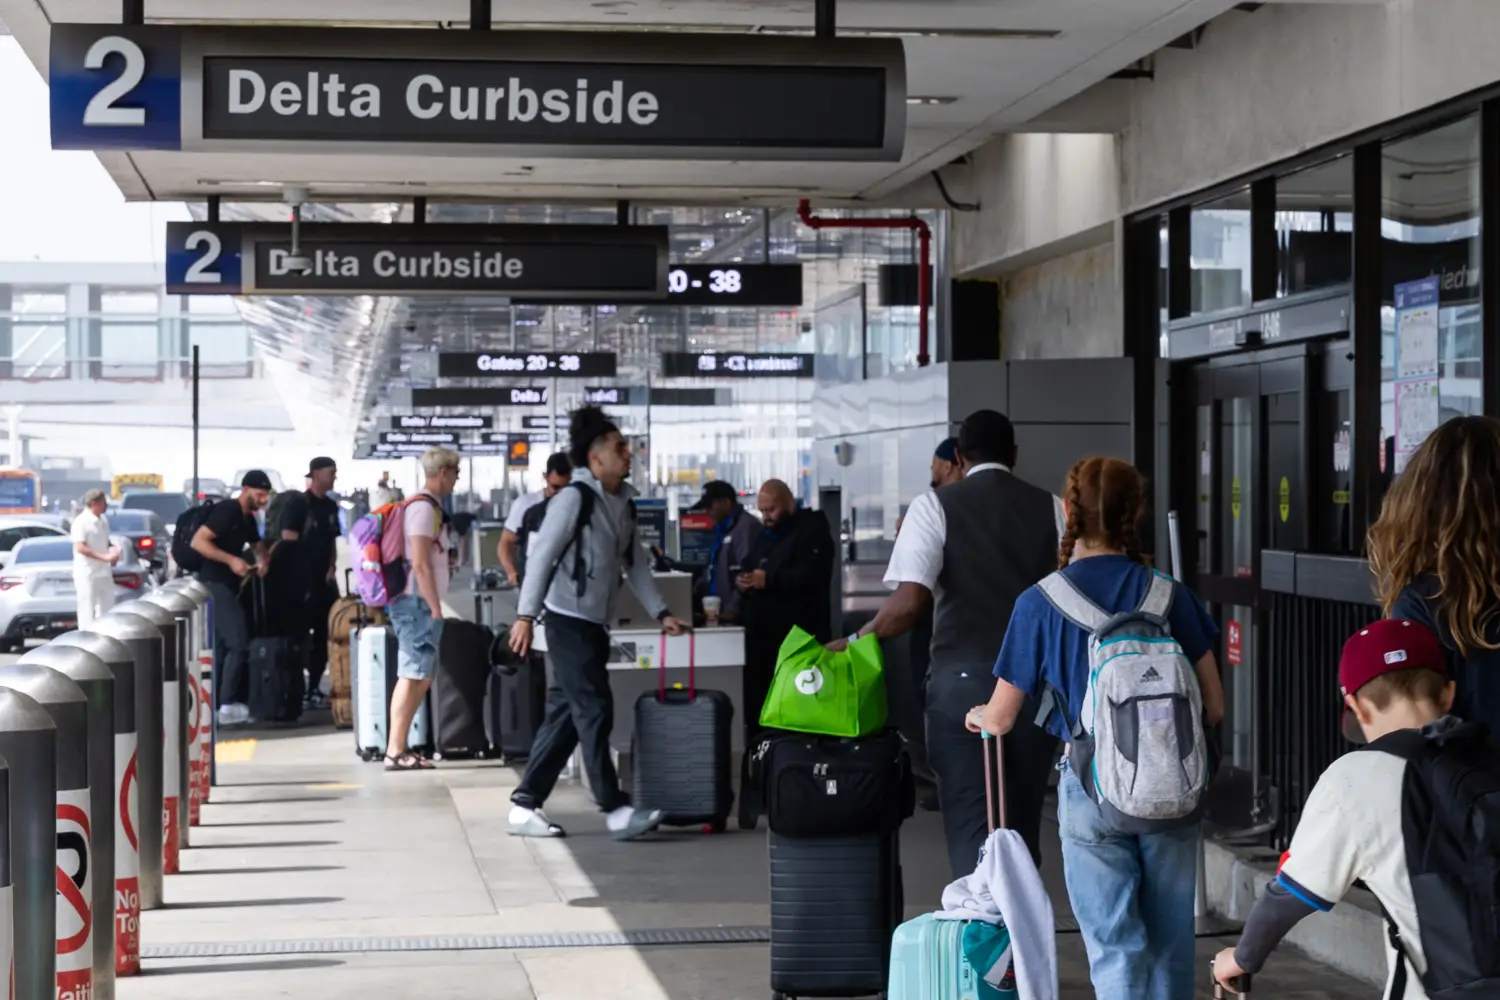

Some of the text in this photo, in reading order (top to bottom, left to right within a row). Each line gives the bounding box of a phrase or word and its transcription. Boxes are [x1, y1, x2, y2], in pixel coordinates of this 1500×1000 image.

[83, 36, 145, 126] 2
[229, 69, 659, 125] Delta Curbside
[184, 230, 222, 284] 2
[373, 250, 523, 278] Curbside
[668, 269, 688, 293] 0
[709, 270, 741, 293] 38
[477, 355, 524, 370] Gates
[527, 355, 547, 370] 20
[559, 355, 580, 370] 38
